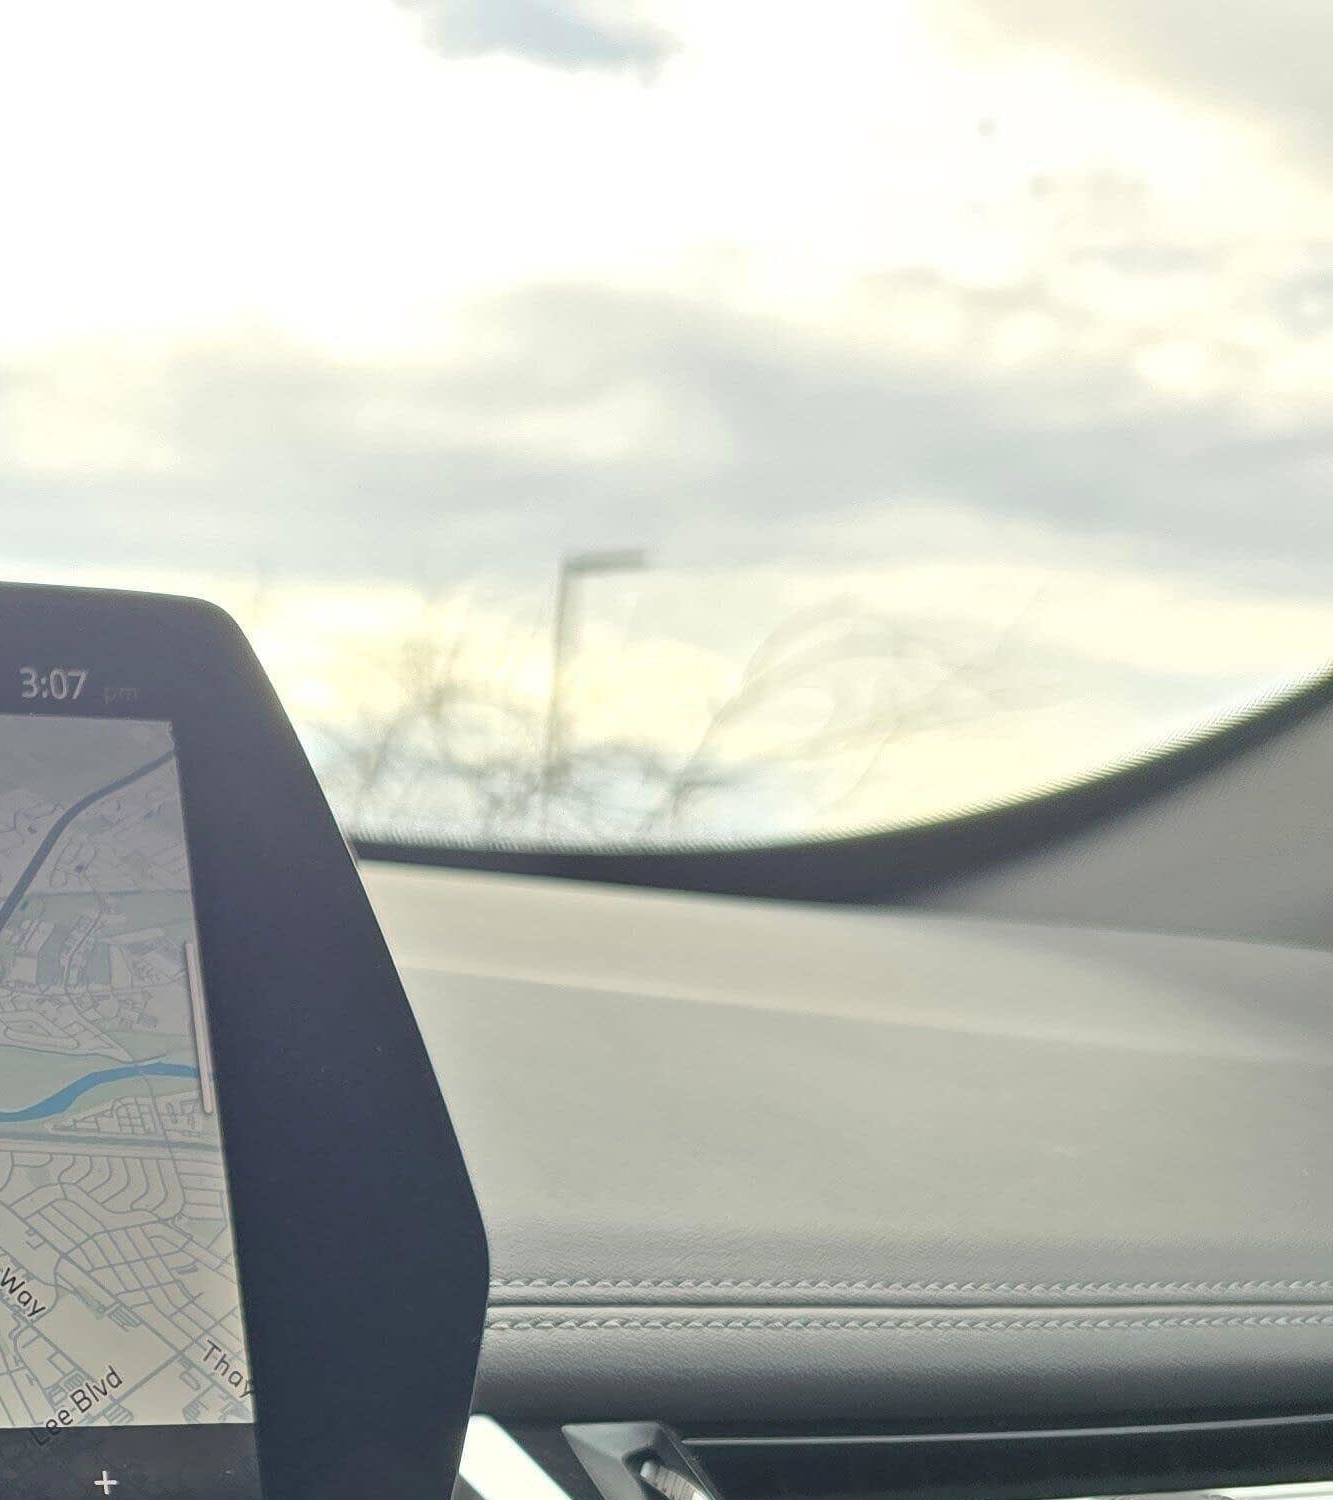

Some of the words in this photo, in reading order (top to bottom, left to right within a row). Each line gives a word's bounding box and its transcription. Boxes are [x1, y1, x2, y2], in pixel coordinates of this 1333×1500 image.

[18, 666, 89, 700] 3:07
[0, 1267, 47, 1319] Way
[29, 1408, 74, 1447] Lee
[69, 1364, 124, 1415] Blvd
